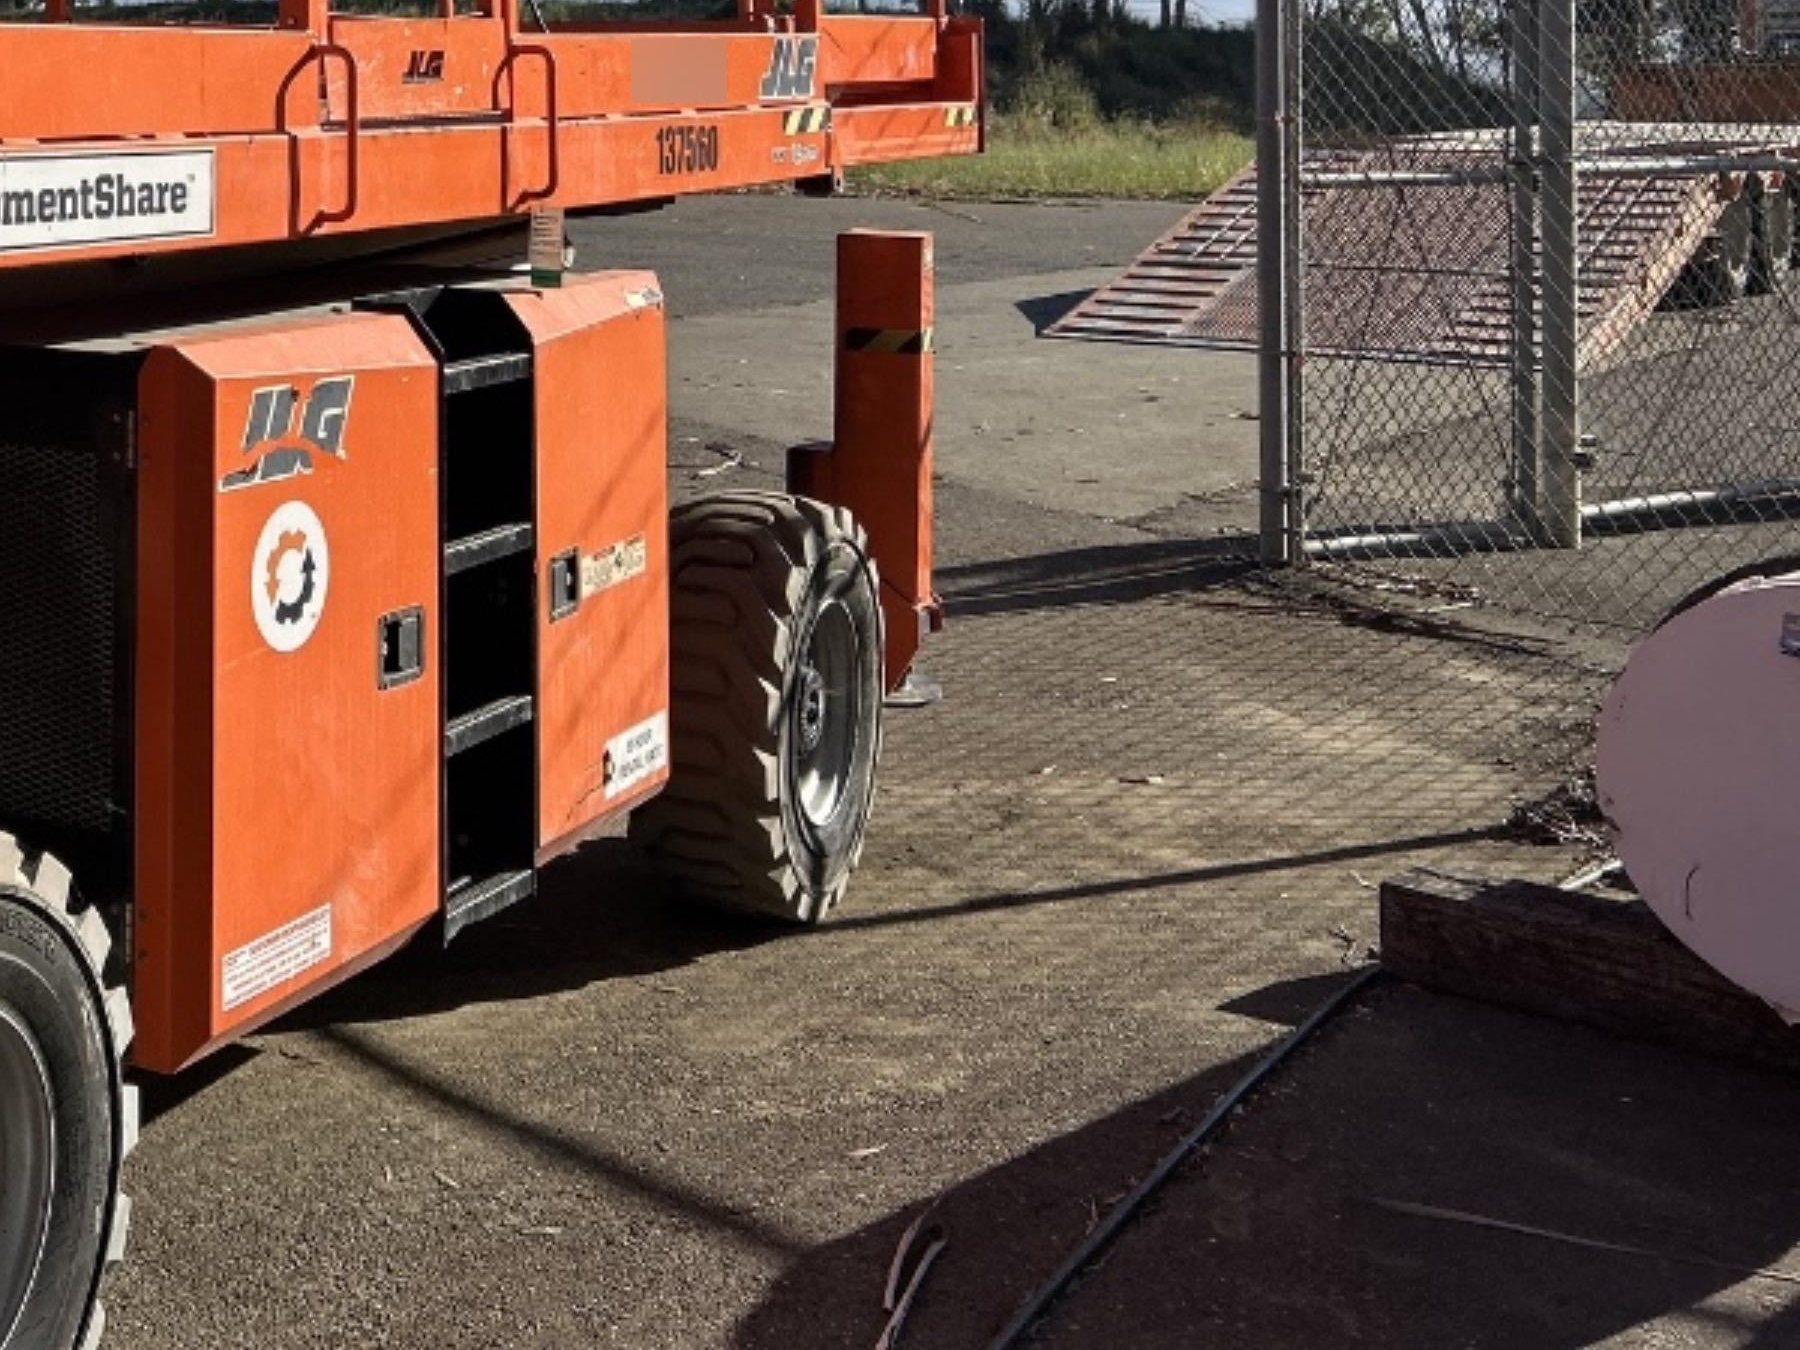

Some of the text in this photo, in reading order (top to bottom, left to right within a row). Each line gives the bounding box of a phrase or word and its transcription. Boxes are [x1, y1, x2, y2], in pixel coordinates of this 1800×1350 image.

[401, 49, 445, 85] JLG
[759, 35, 817, 99] JLG
[656, 125, 719, 175] 137560
